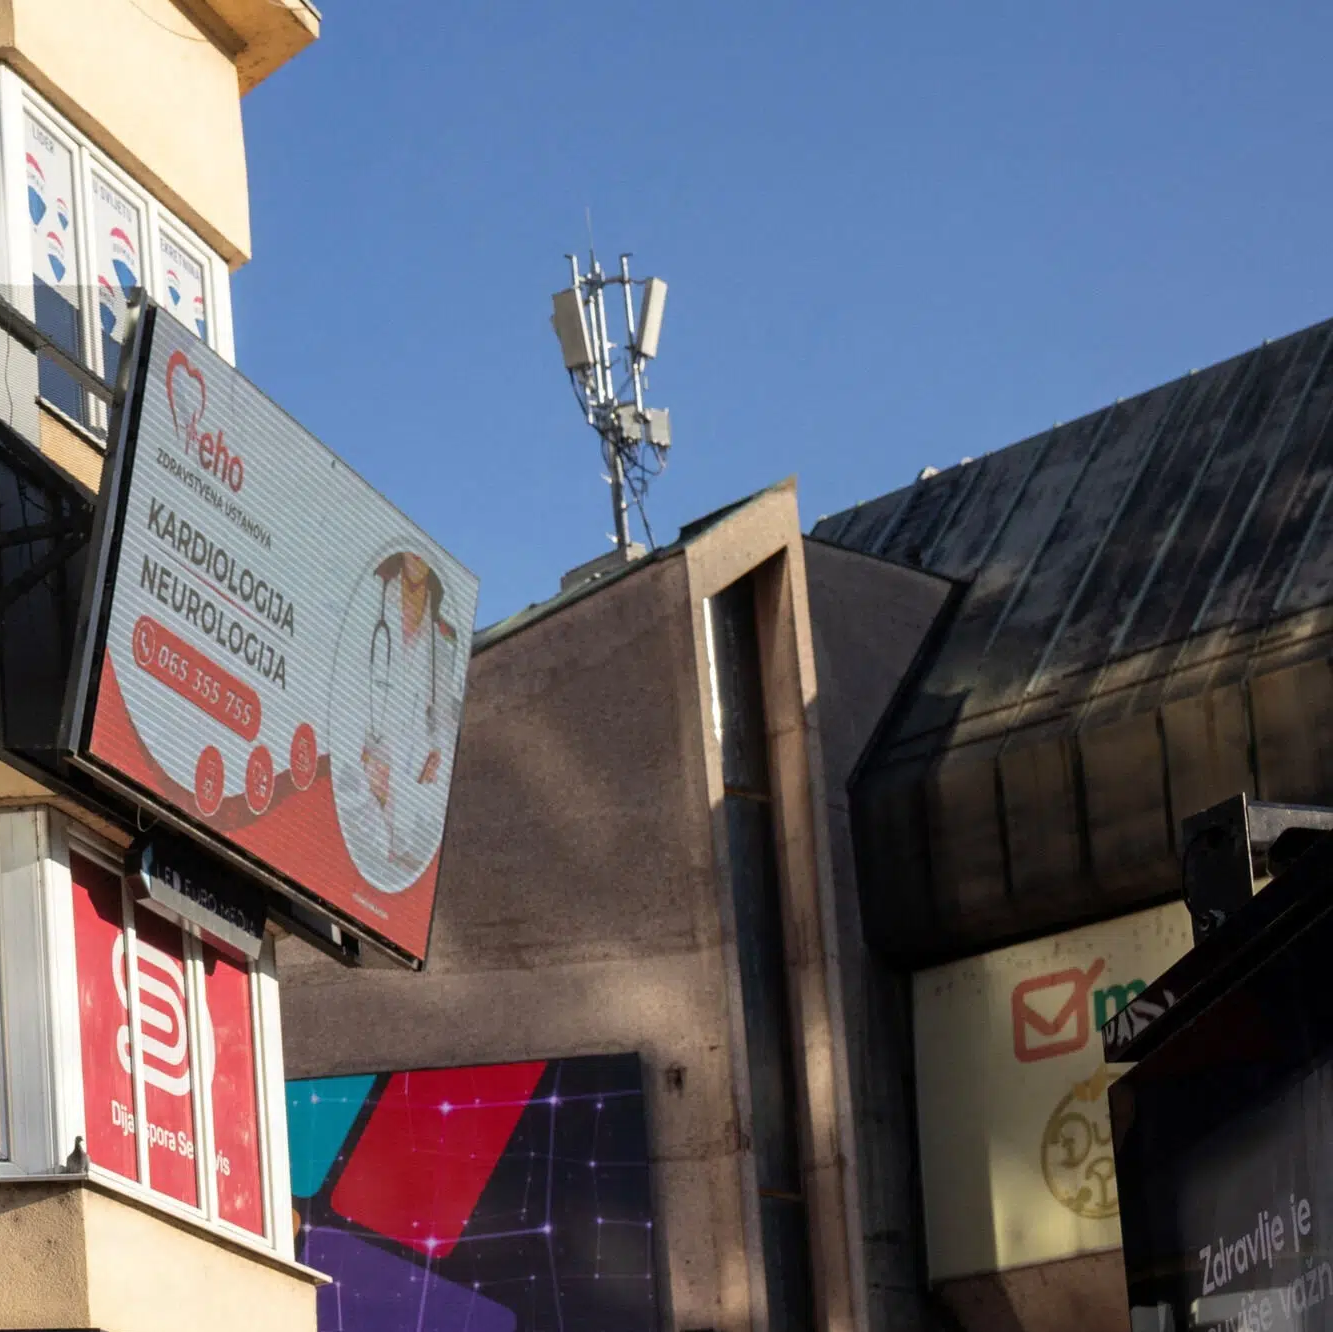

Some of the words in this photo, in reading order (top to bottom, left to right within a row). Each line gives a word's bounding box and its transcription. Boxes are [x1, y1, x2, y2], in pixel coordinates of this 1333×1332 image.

[156, 447, 223, 516] ZDRAVSTVENA
[224, 498, 272, 550] USTANOVA
[148, 497, 296, 638] KARDIOLOGIJA
[141, 555, 287, 690] NEUROLOGIJA
[157, 645, 189, 682] 065
[192, 670, 223, 706] 355
[225, 691, 253, 728] 755
[1200, 1211, 1283, 1295] Zdravlje
[1289, 1194, 1312, 1252] je
